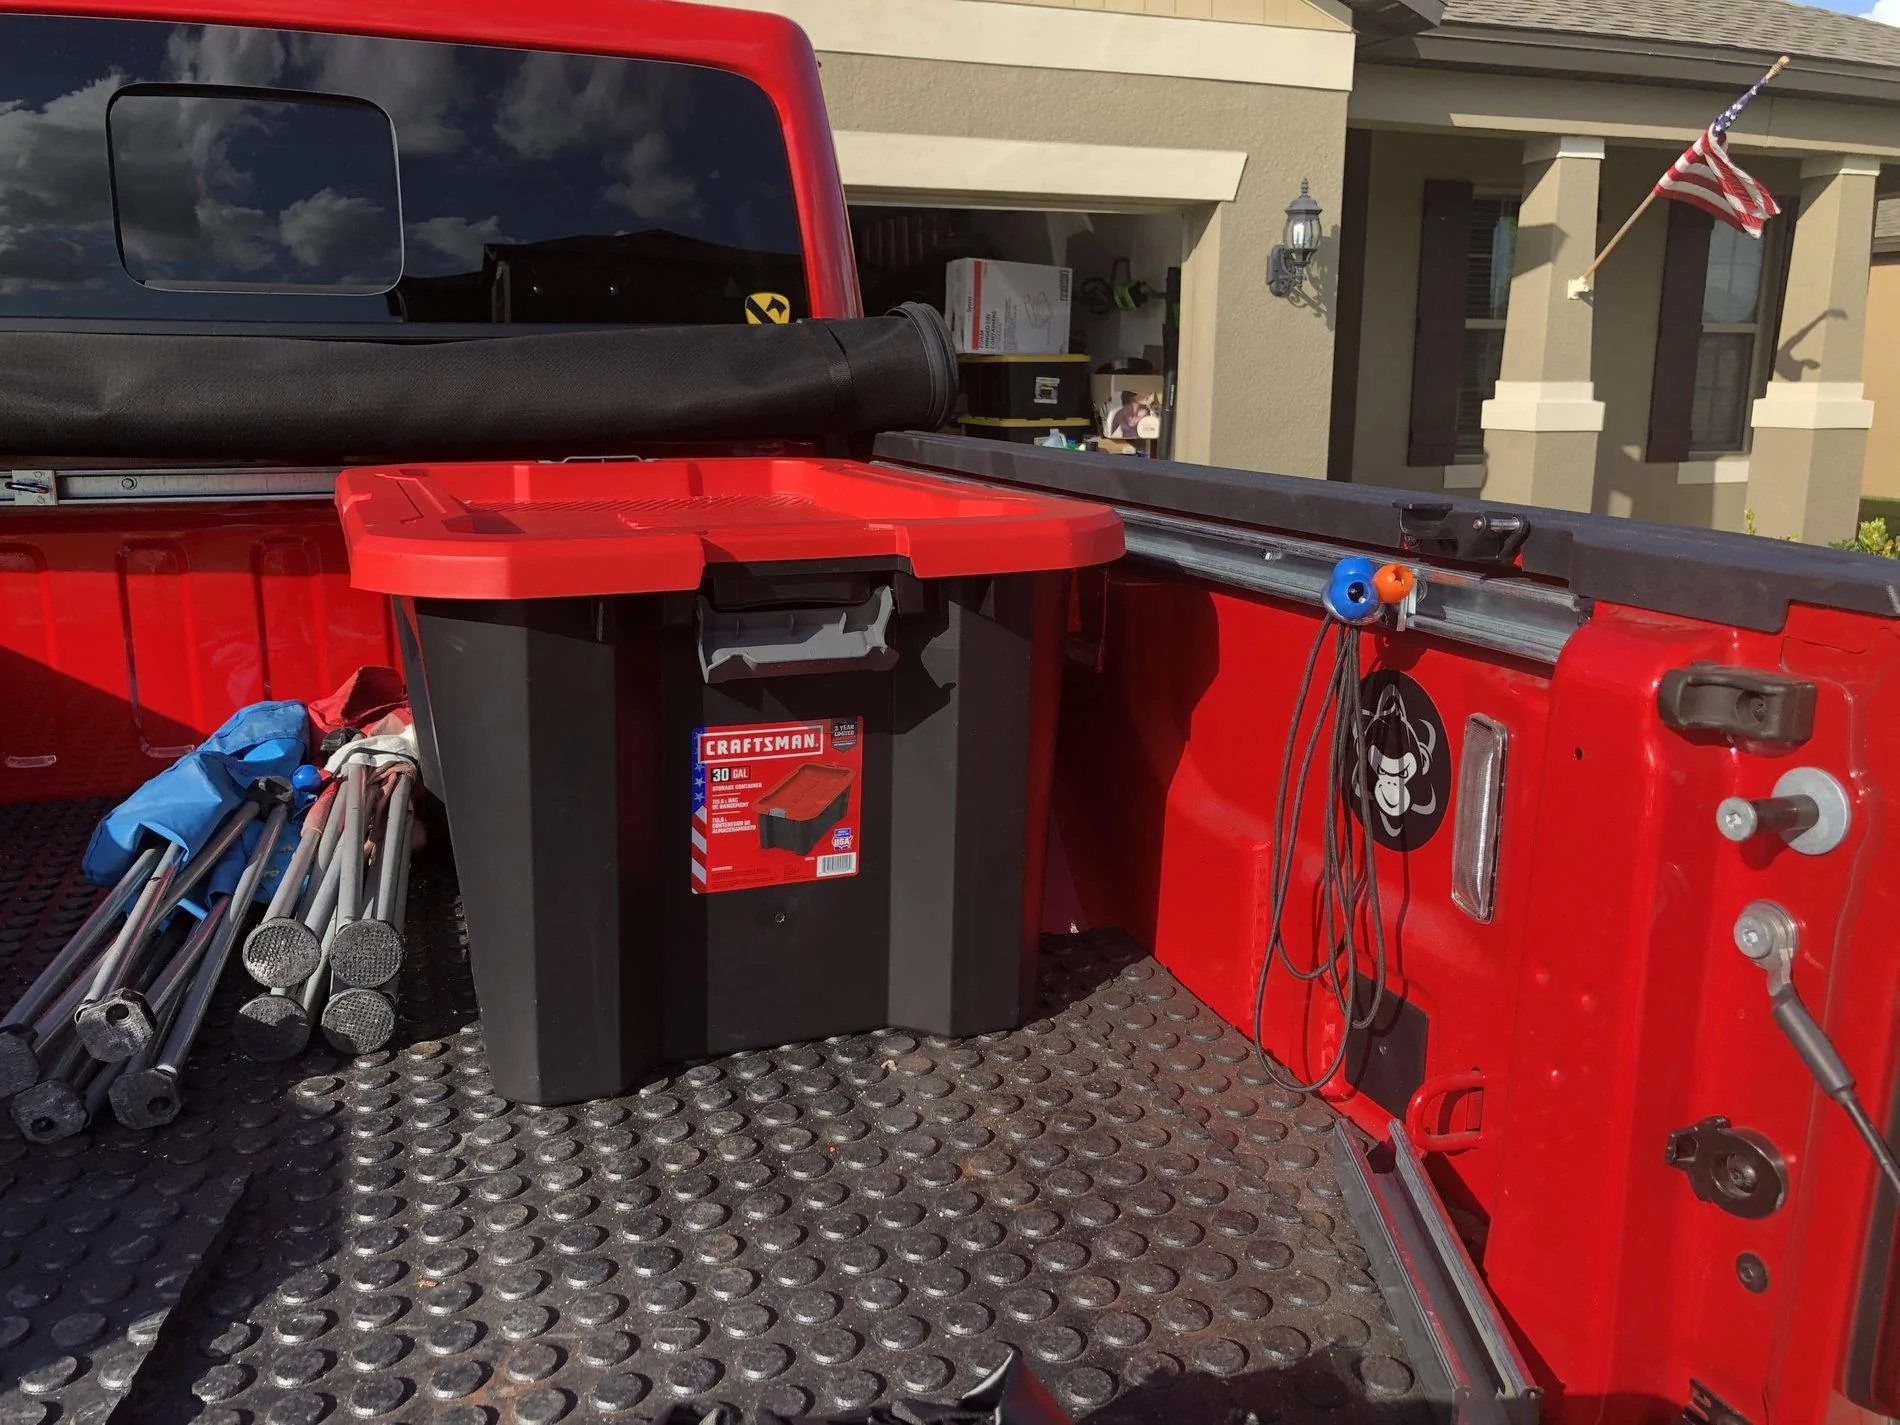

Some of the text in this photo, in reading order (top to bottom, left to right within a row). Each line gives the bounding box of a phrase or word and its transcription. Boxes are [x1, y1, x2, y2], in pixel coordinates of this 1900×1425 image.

[705, 733, 816, 756] CRAFTSMAN
[712, 768, 748, 782] 30 GAL
[735, 782, 762, 790] CONTAINER
